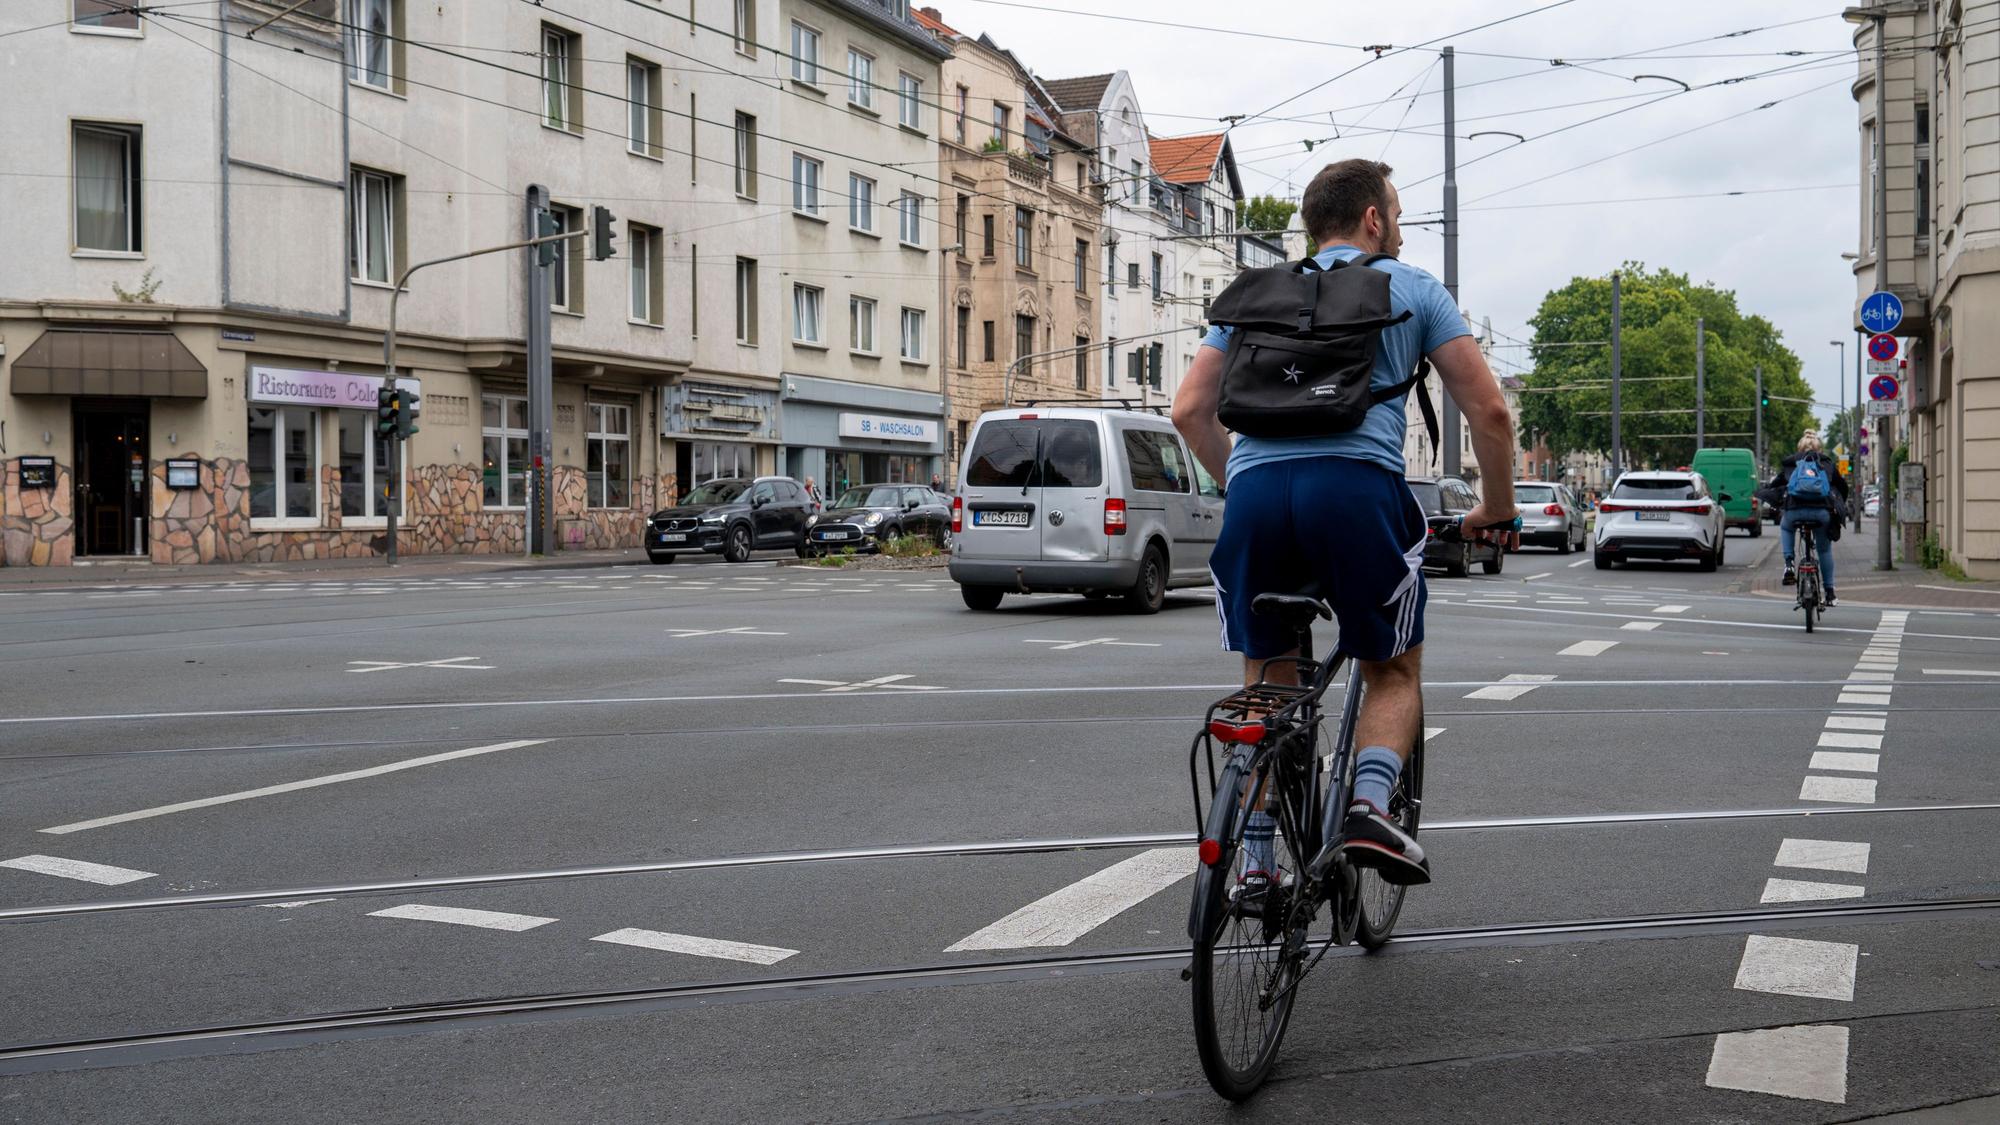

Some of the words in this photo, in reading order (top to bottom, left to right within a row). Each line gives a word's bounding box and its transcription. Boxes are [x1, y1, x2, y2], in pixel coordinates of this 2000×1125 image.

[257, 372, 337, 399] Ristorante
[346, 381, 379, 402] Colo
[861, 420, 871, 432] SB
[880, 422, 924, 436] WASCHSALON
[1004, 511, 1027, 524] 1718
